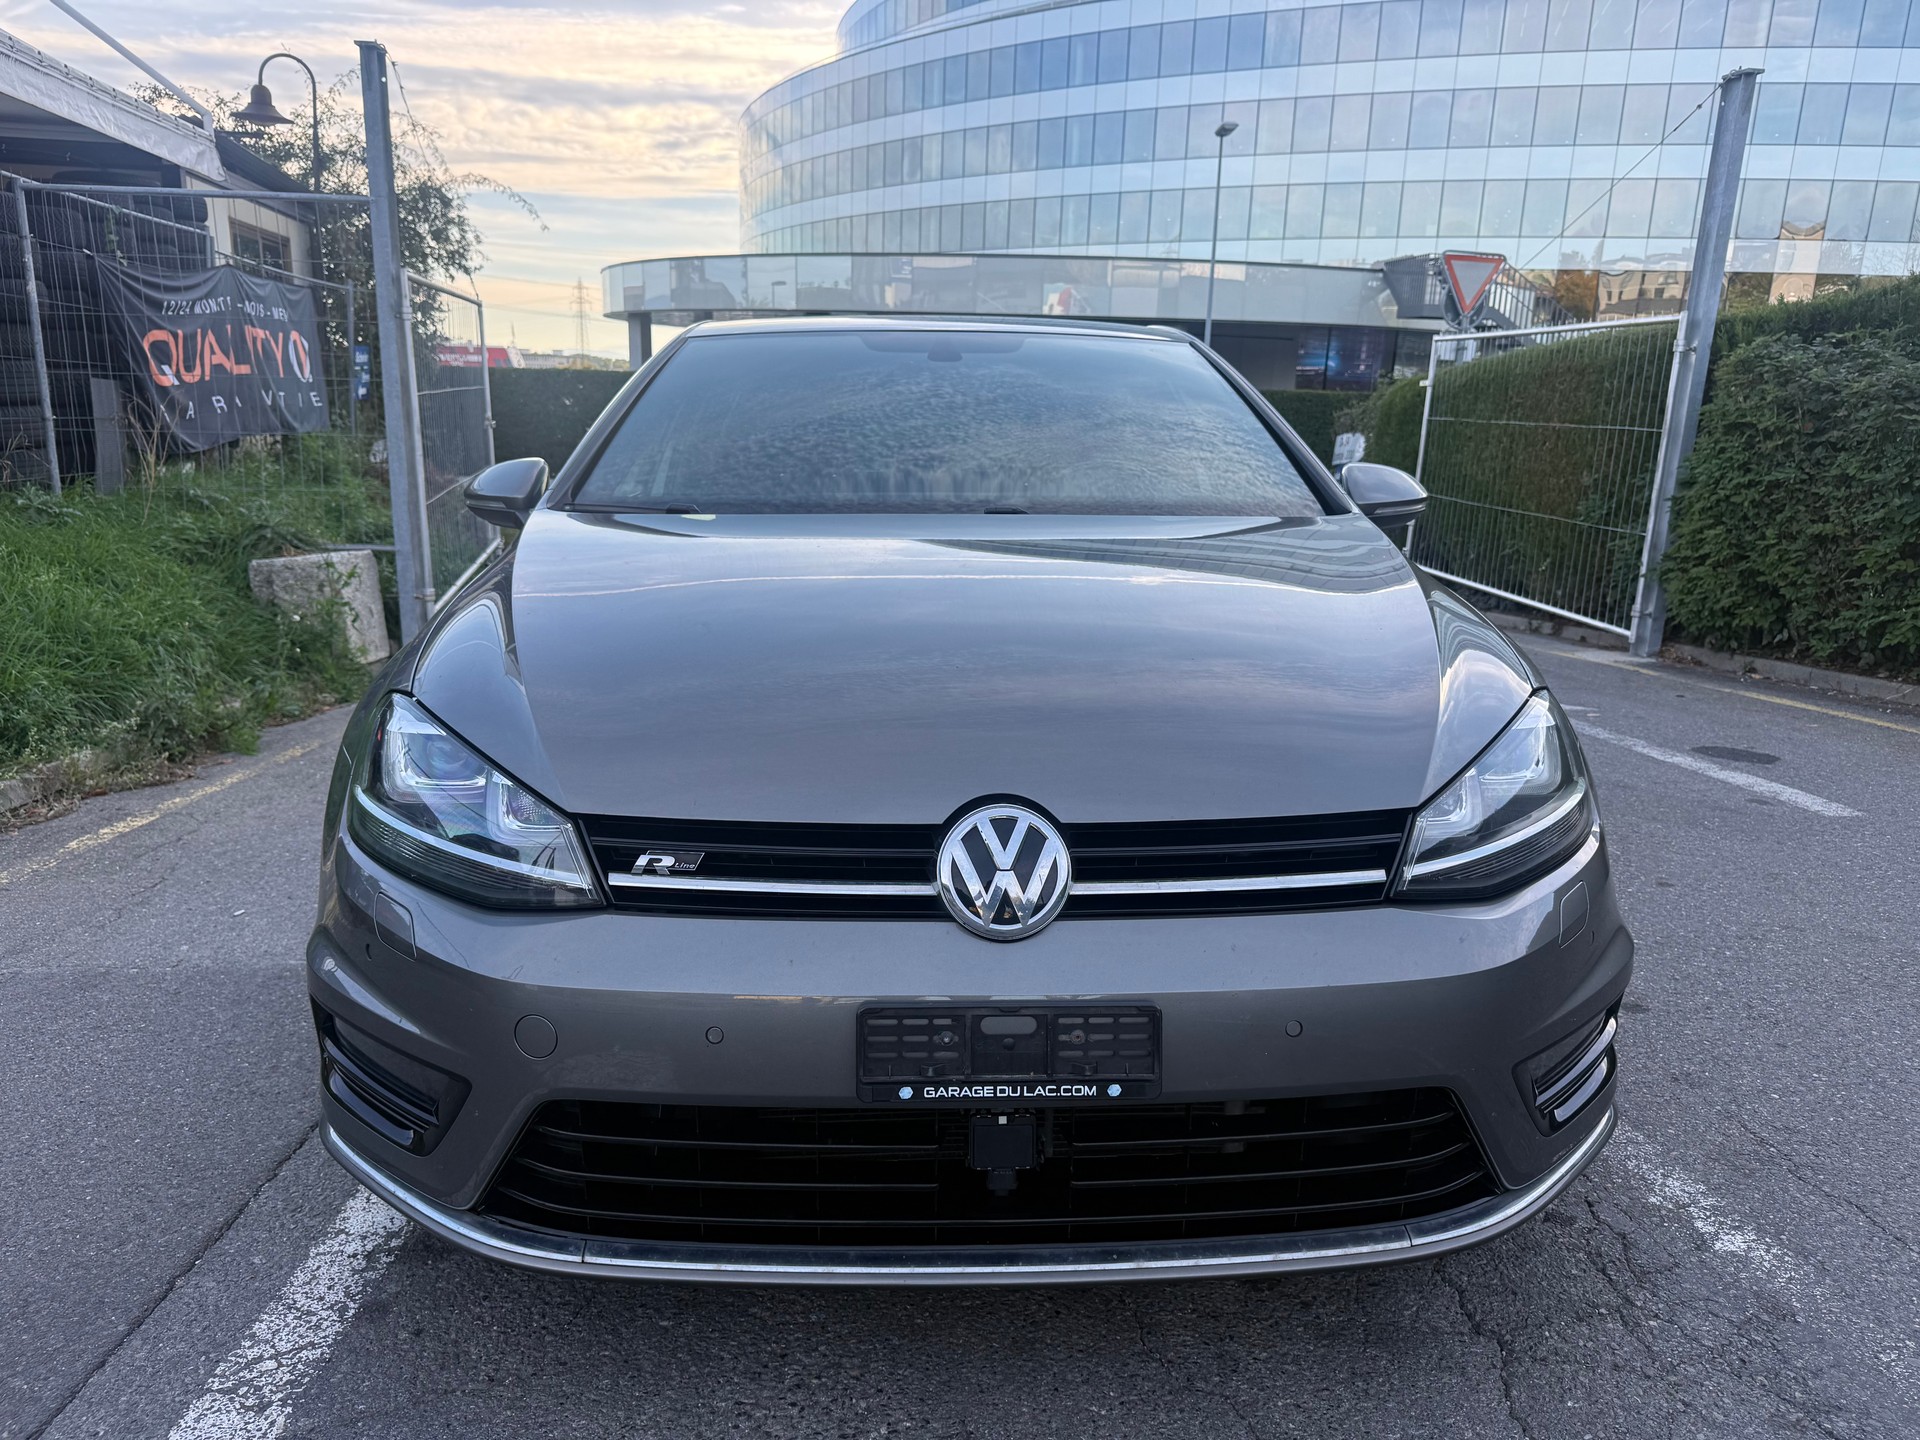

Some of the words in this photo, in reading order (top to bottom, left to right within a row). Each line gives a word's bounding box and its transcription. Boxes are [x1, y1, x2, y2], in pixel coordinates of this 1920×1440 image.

[631, 854, 676, 876] R
[923, 1086, 994, 1098] GARAGE
[996, 1085, 1021, 1097] DU
[1023, 1085, 1097, 1097] LAC.COM
